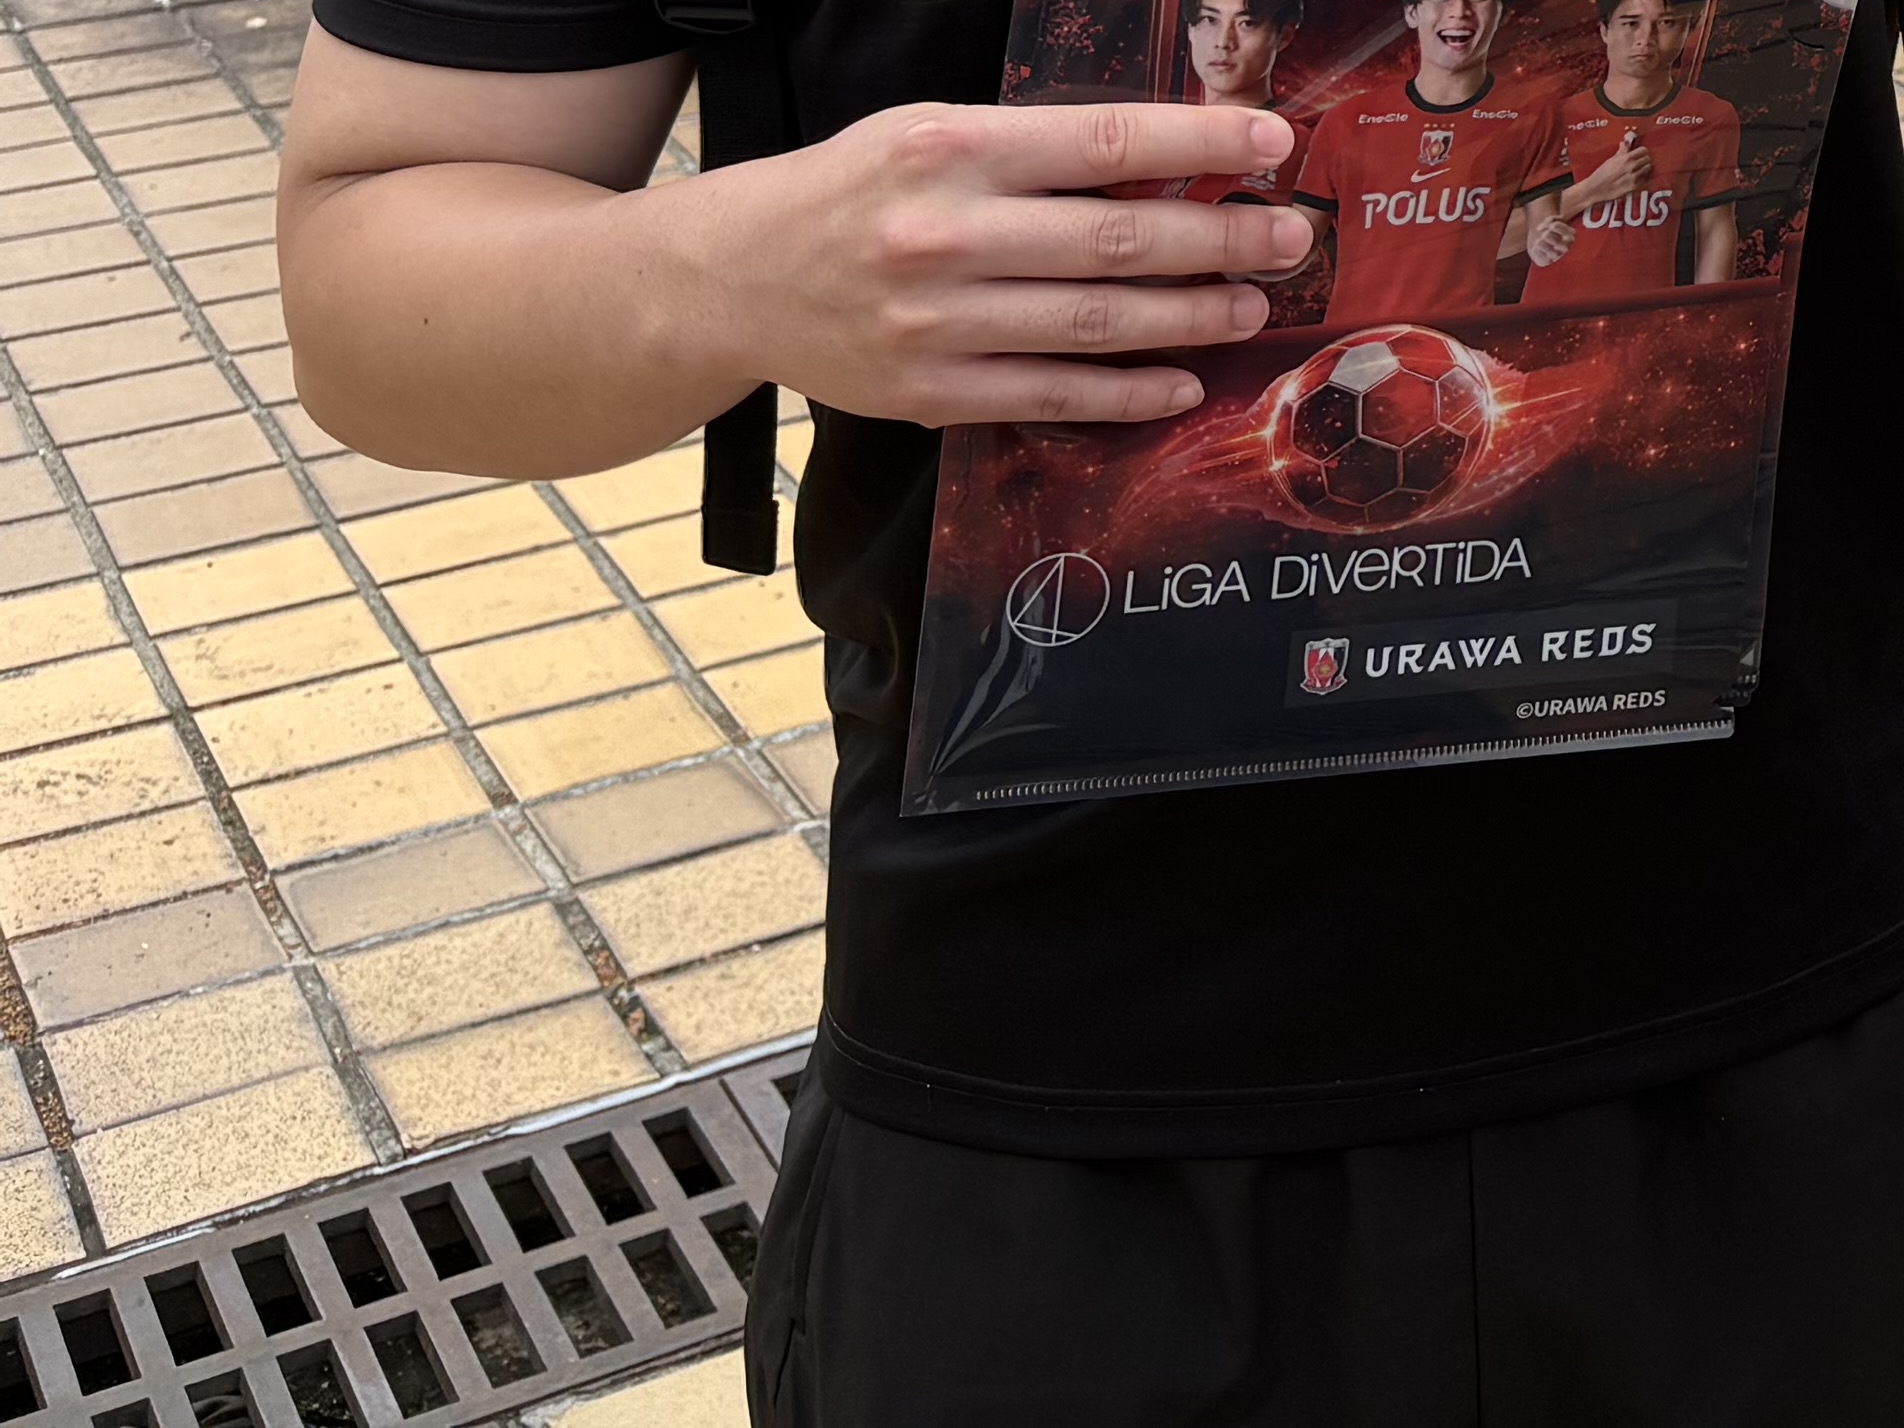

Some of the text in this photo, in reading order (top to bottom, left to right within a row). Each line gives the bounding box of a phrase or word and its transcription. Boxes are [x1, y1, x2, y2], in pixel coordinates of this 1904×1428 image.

[1361, 186, 1491, 229] POLUS
[1582, 189, 1673, 229] OLUS
[1365, 623, 1657, 677] URAWA REDS
[1613, 690, 1667, 711] REDS
